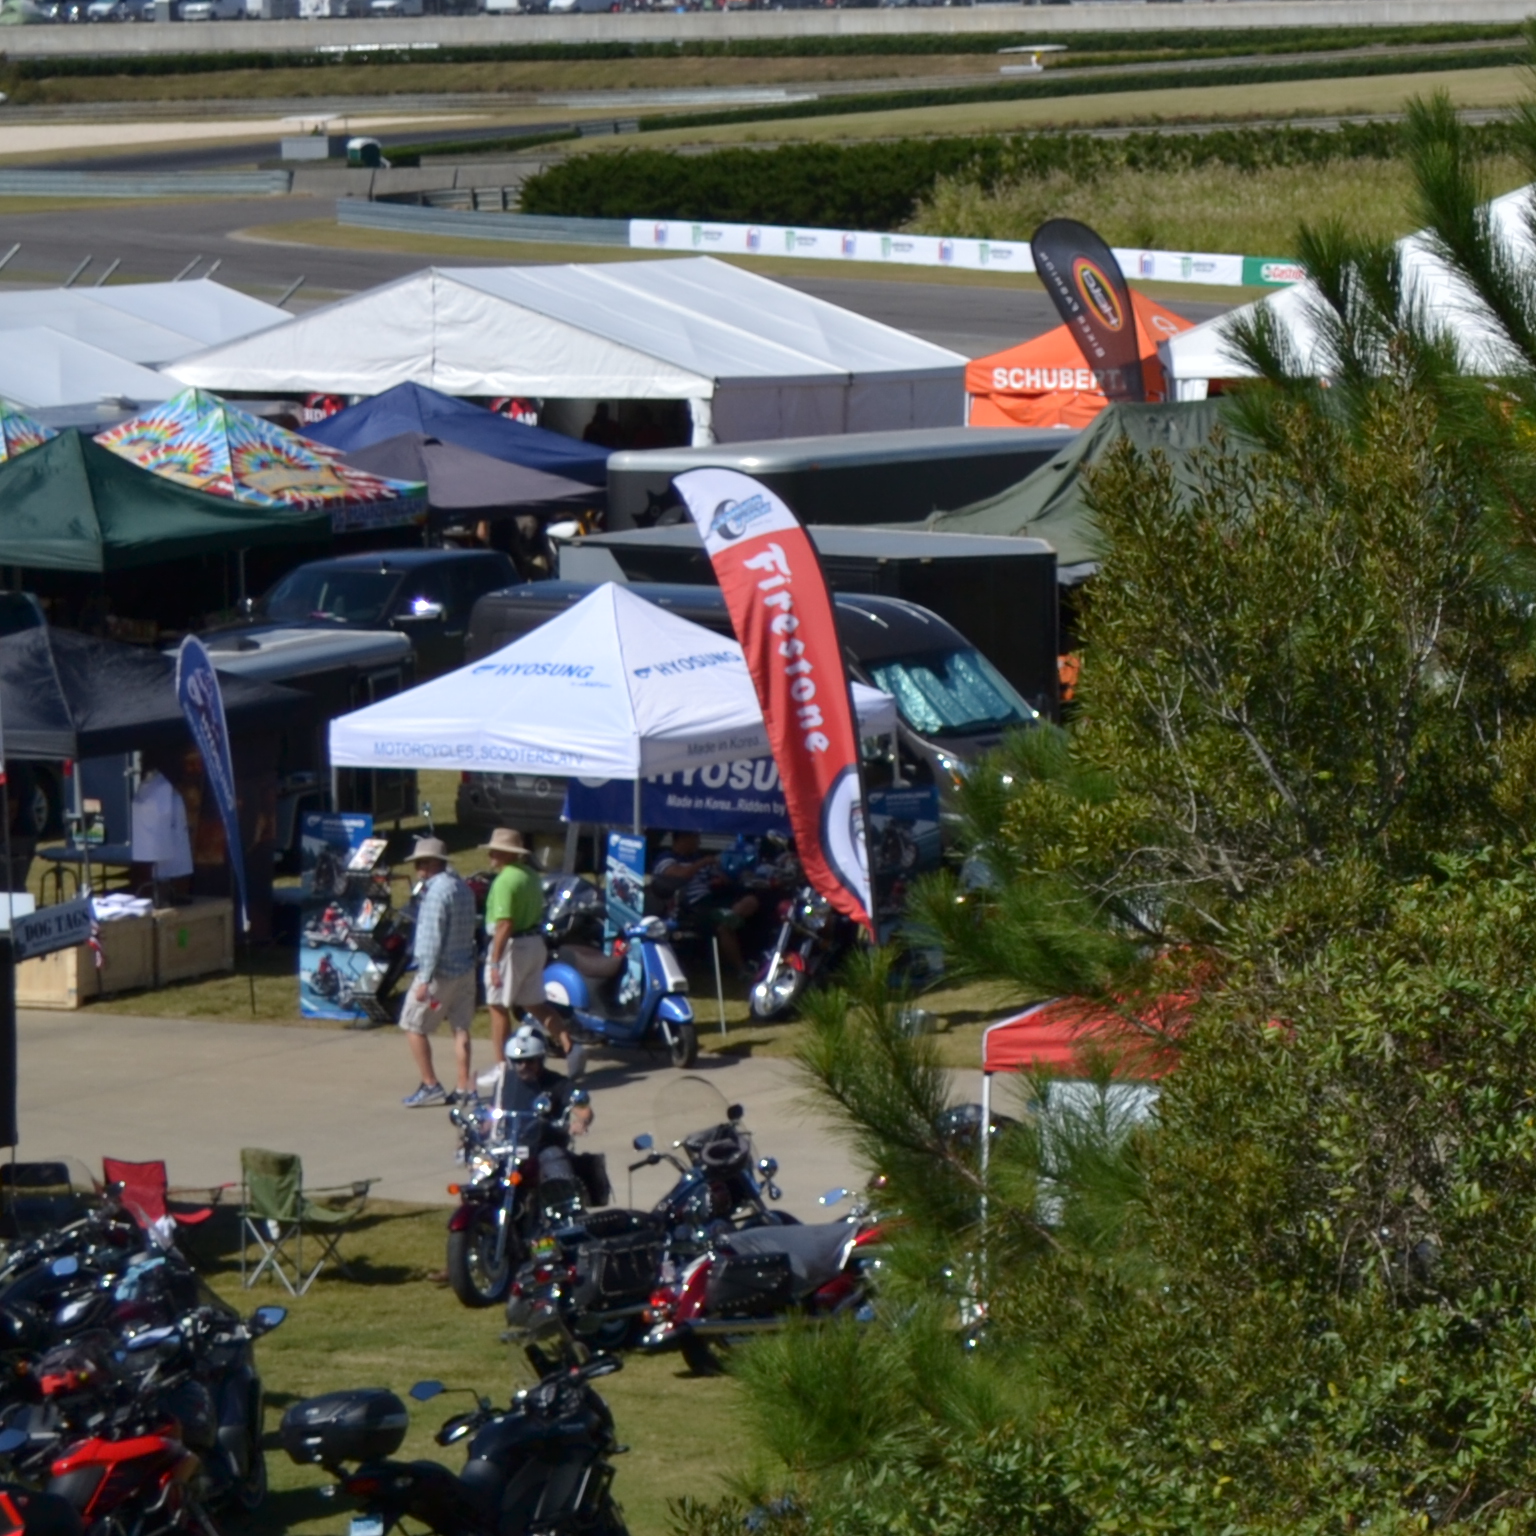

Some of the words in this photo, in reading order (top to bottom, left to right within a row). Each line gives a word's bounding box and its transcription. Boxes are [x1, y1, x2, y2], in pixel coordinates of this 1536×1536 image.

[992, 367, 1127, 390] SCHUBERT
[743, 542, 830, 754] Firestone
[495, 662, 596, 679] HYOSUNG
[653, 650, 743, 677] HYOSUNG
[647, 759, 784, 791] YOSU
[666, 794, 692, 808] Made
[694, 797, 703, 809] in
[772, 800, 786, 817] by
[25, 919, 52, 941] DOG
[55, 907, 90, 933] TAGS
